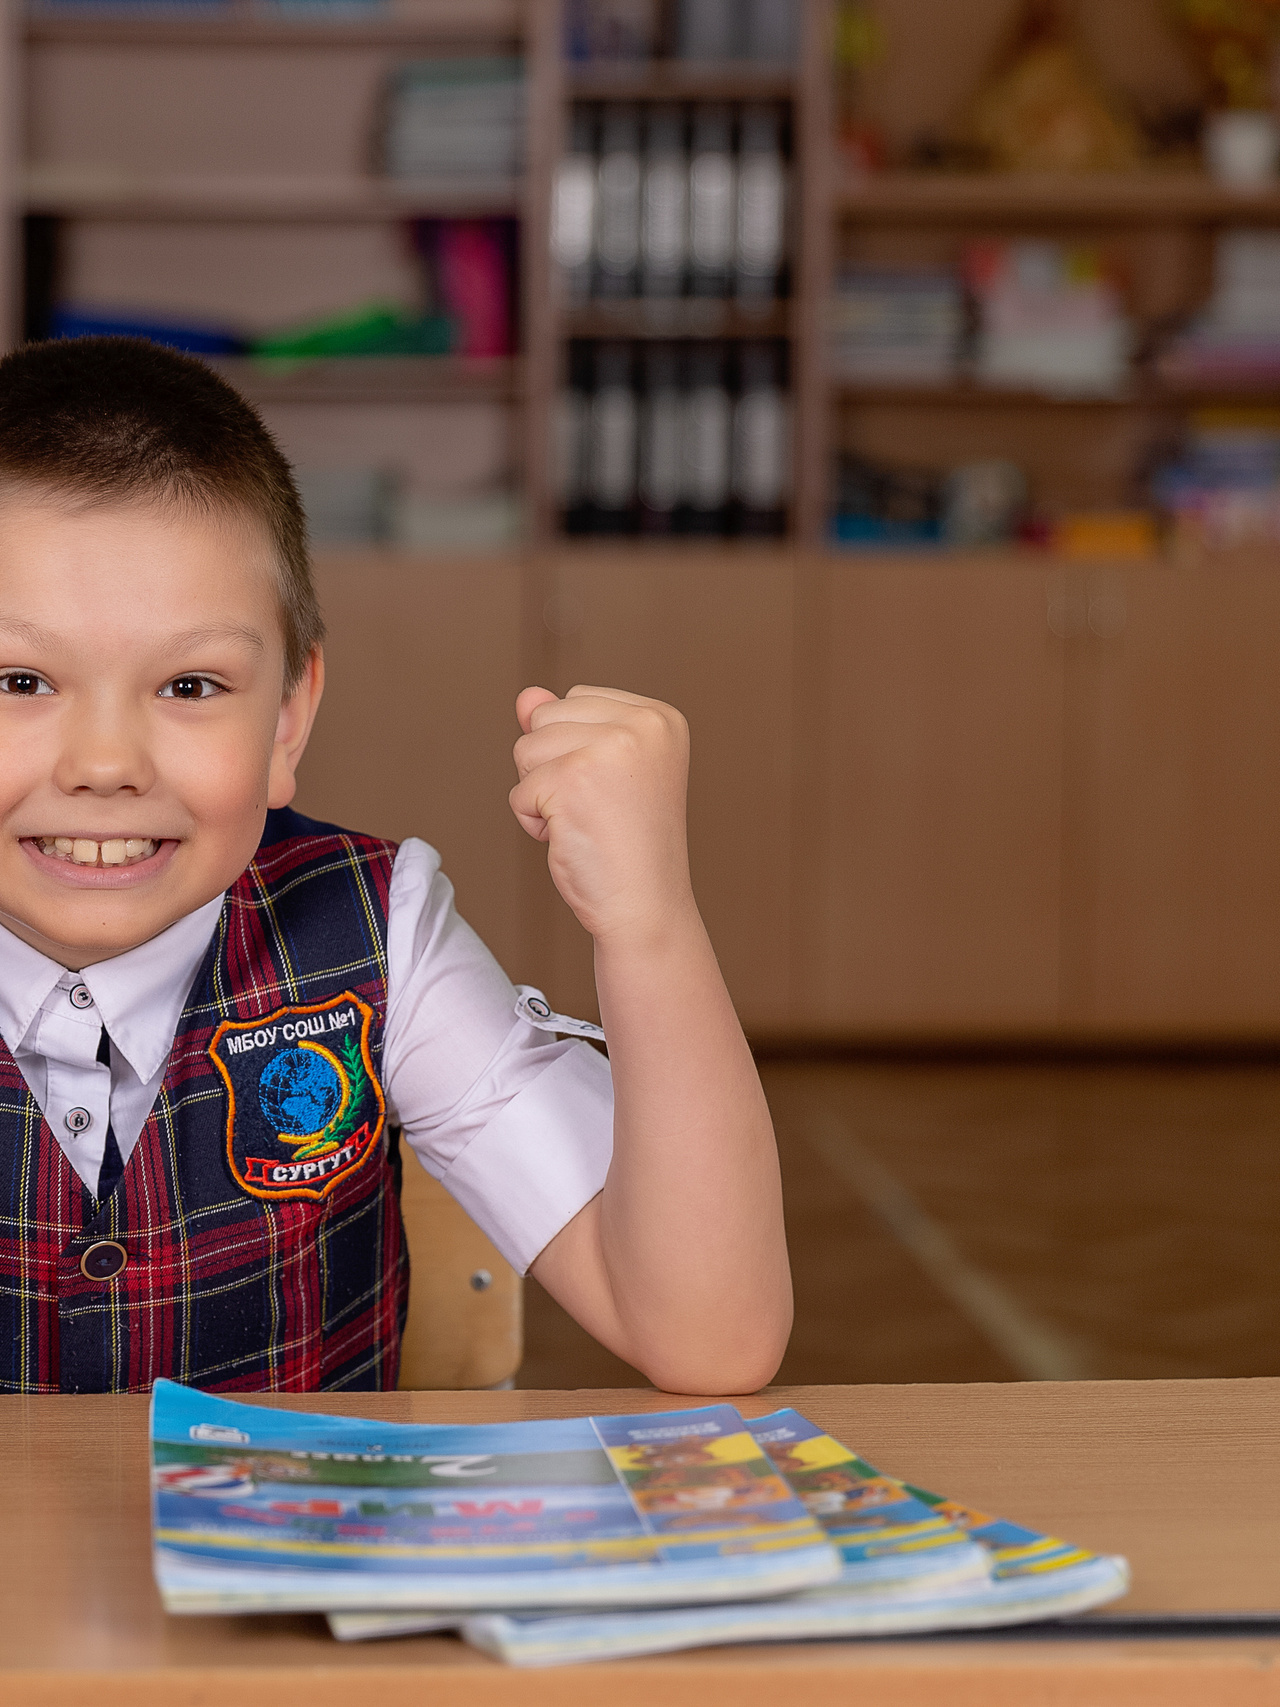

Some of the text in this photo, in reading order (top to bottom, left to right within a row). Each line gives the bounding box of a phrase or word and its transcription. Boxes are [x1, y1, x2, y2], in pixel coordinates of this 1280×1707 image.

[227, 1007, 356, 1055] МБОУ СОШ №1
[272, 1145, 354, 1182] СУРГУТ
[421, 1454, 499, 1478] 2
